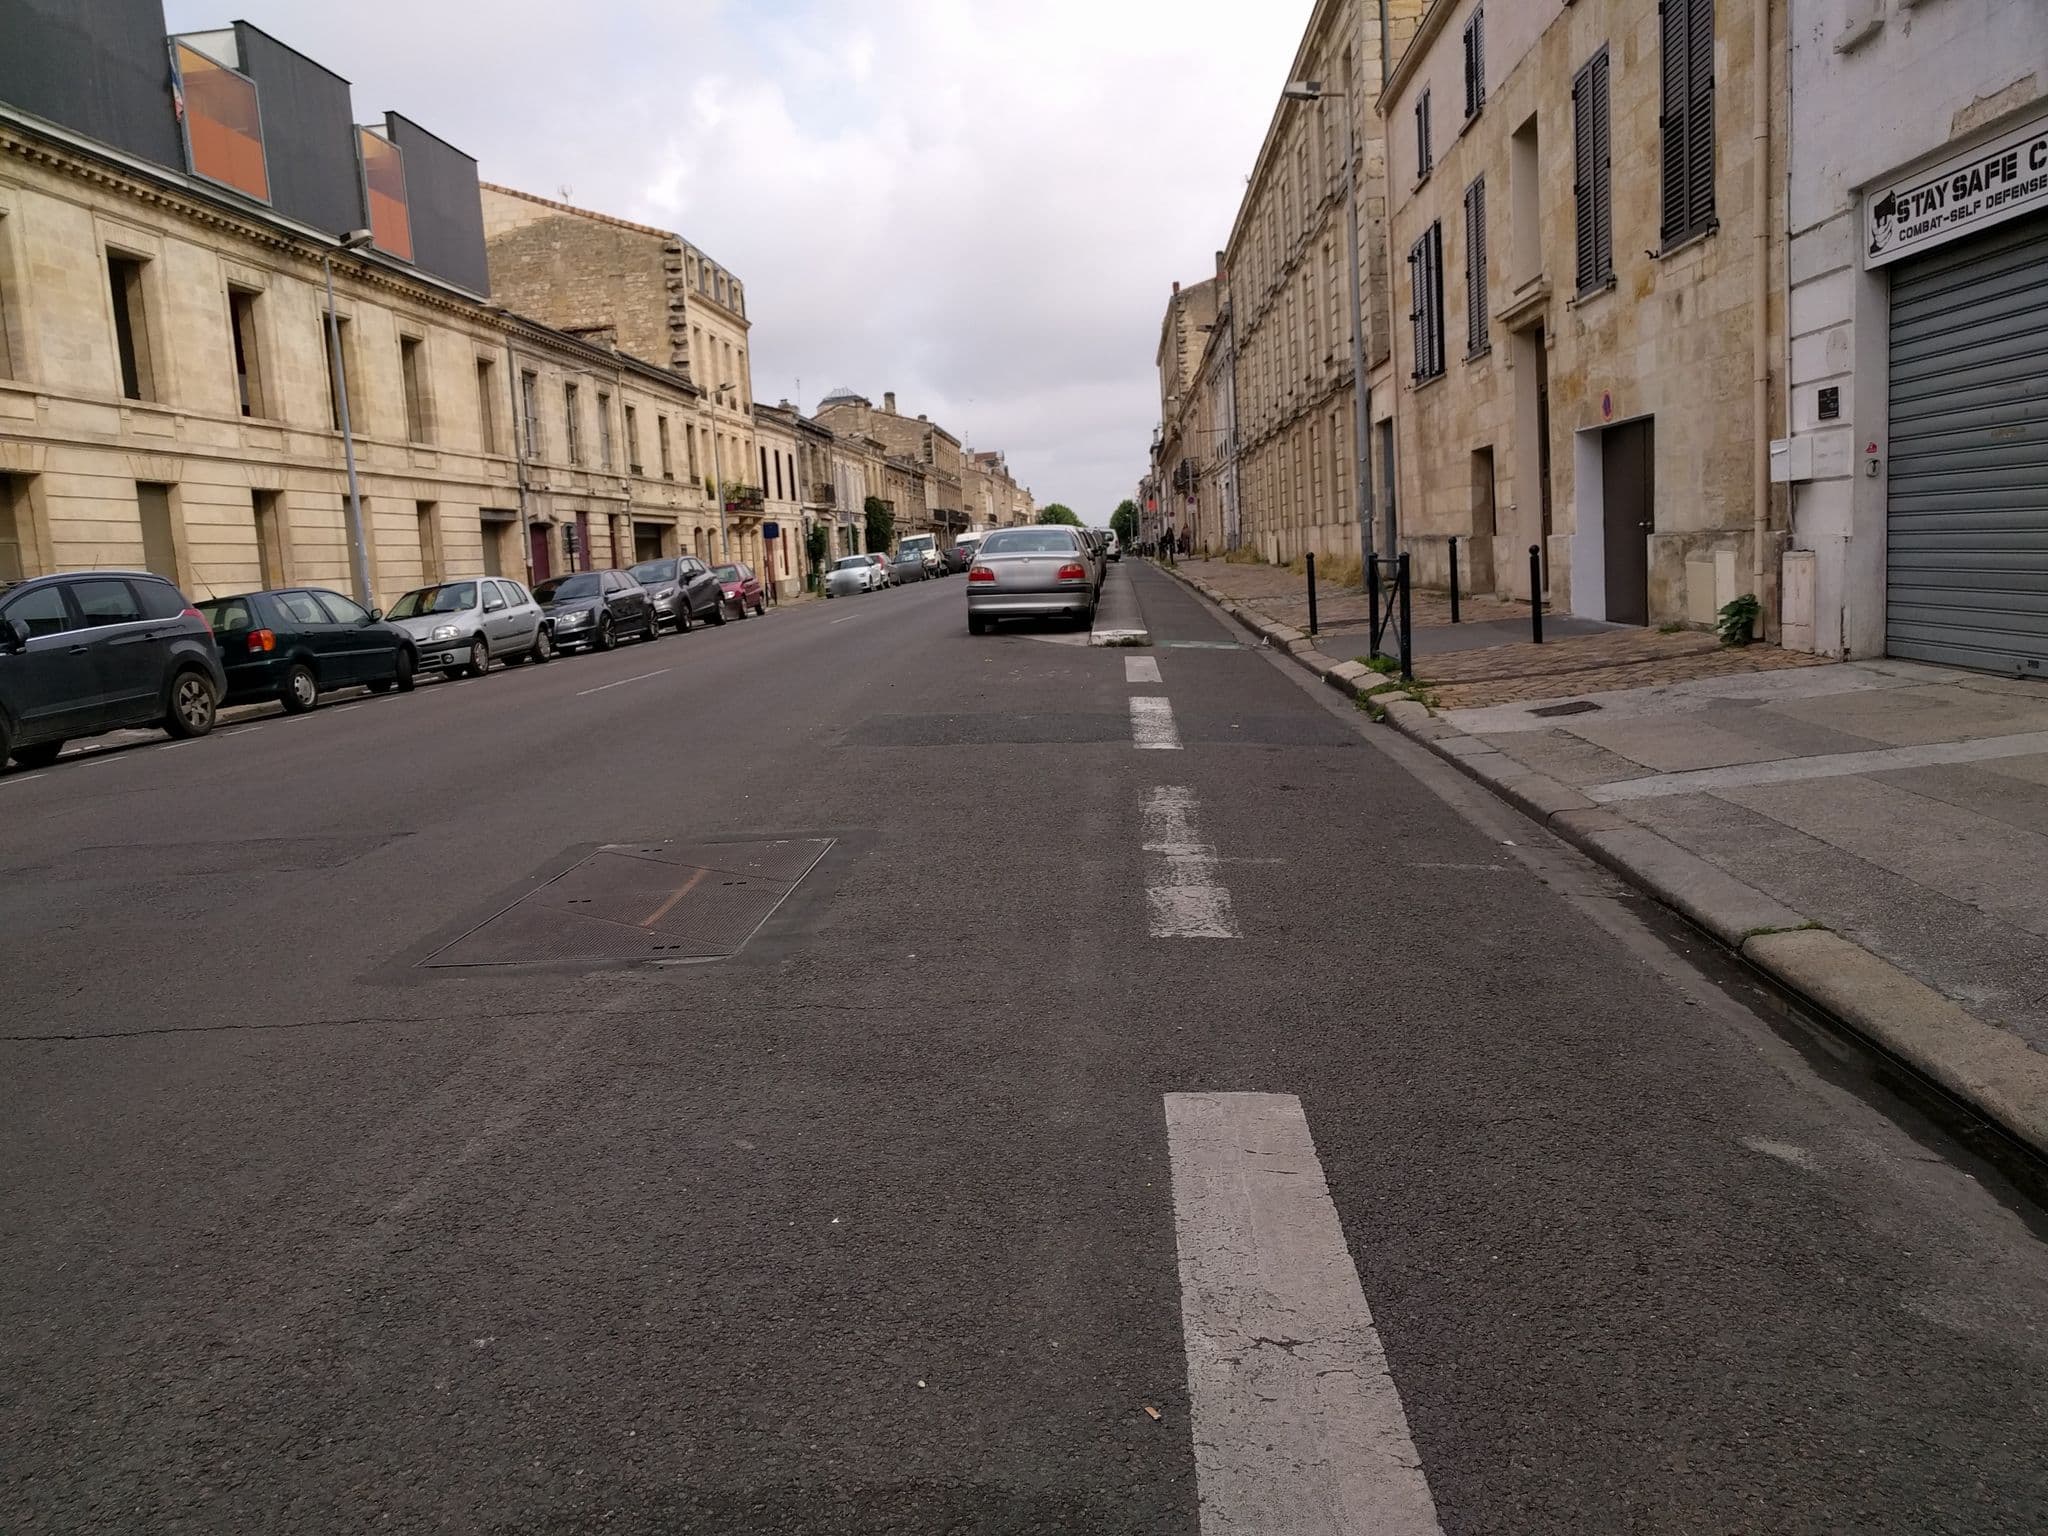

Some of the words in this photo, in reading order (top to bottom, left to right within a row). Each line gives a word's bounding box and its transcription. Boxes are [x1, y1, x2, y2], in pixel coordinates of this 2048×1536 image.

[1897, 181, 1949, 224] STAY
[1952, 152, 2018, 202] SAFE
[1899, 200, 1981, 241] COMBAT-SELF
[1986, 174, 2048, 209] DEFENSE
